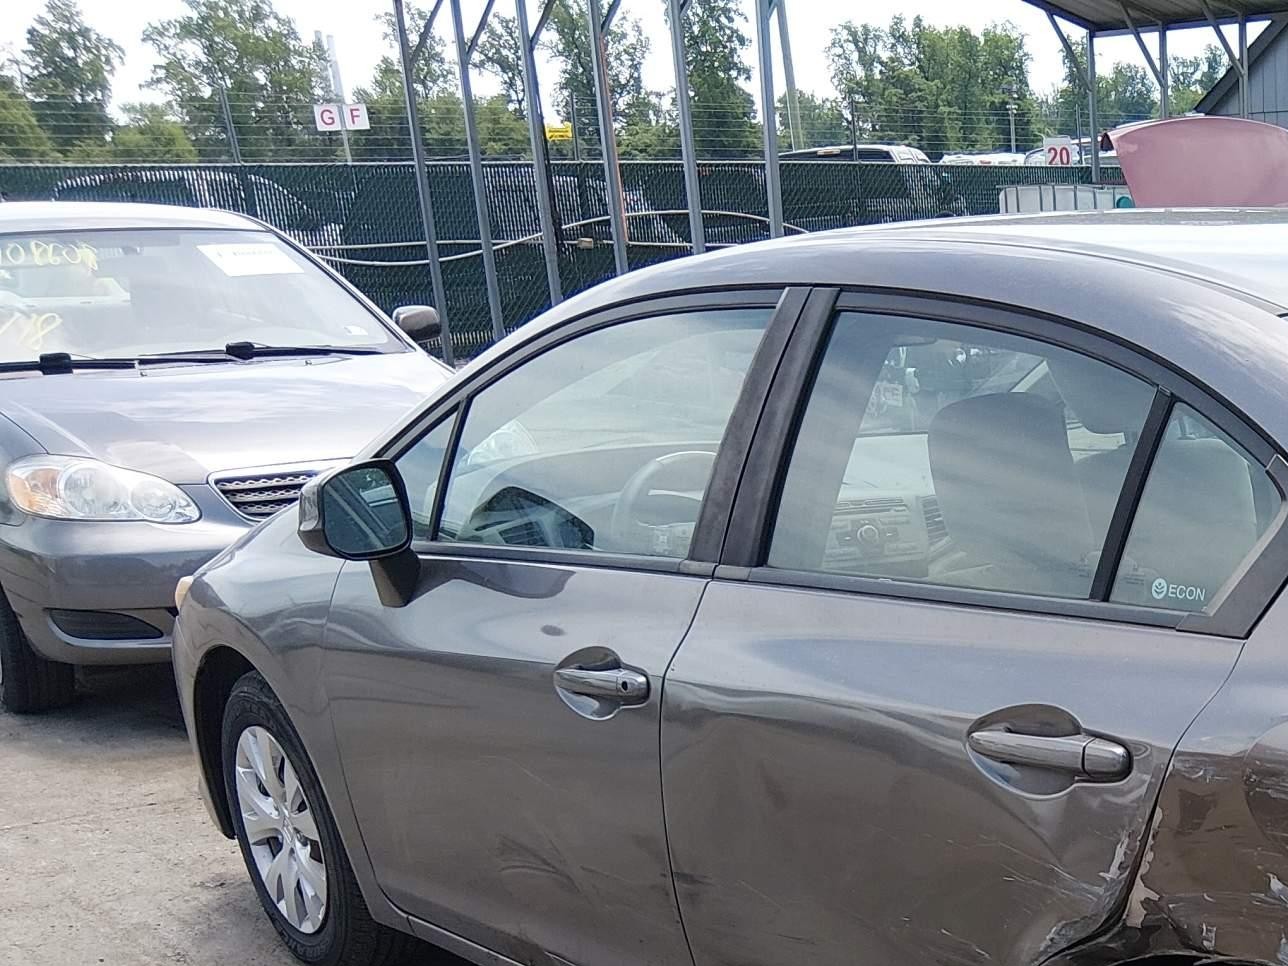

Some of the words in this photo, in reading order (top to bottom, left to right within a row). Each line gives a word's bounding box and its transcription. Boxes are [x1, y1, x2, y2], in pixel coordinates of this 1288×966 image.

[320, 109, 335, 125] G
[350, 108, 360, 125] F
[1047, 146, 1071, 166] 20
[1168, 584, 1206, 601] ECON
